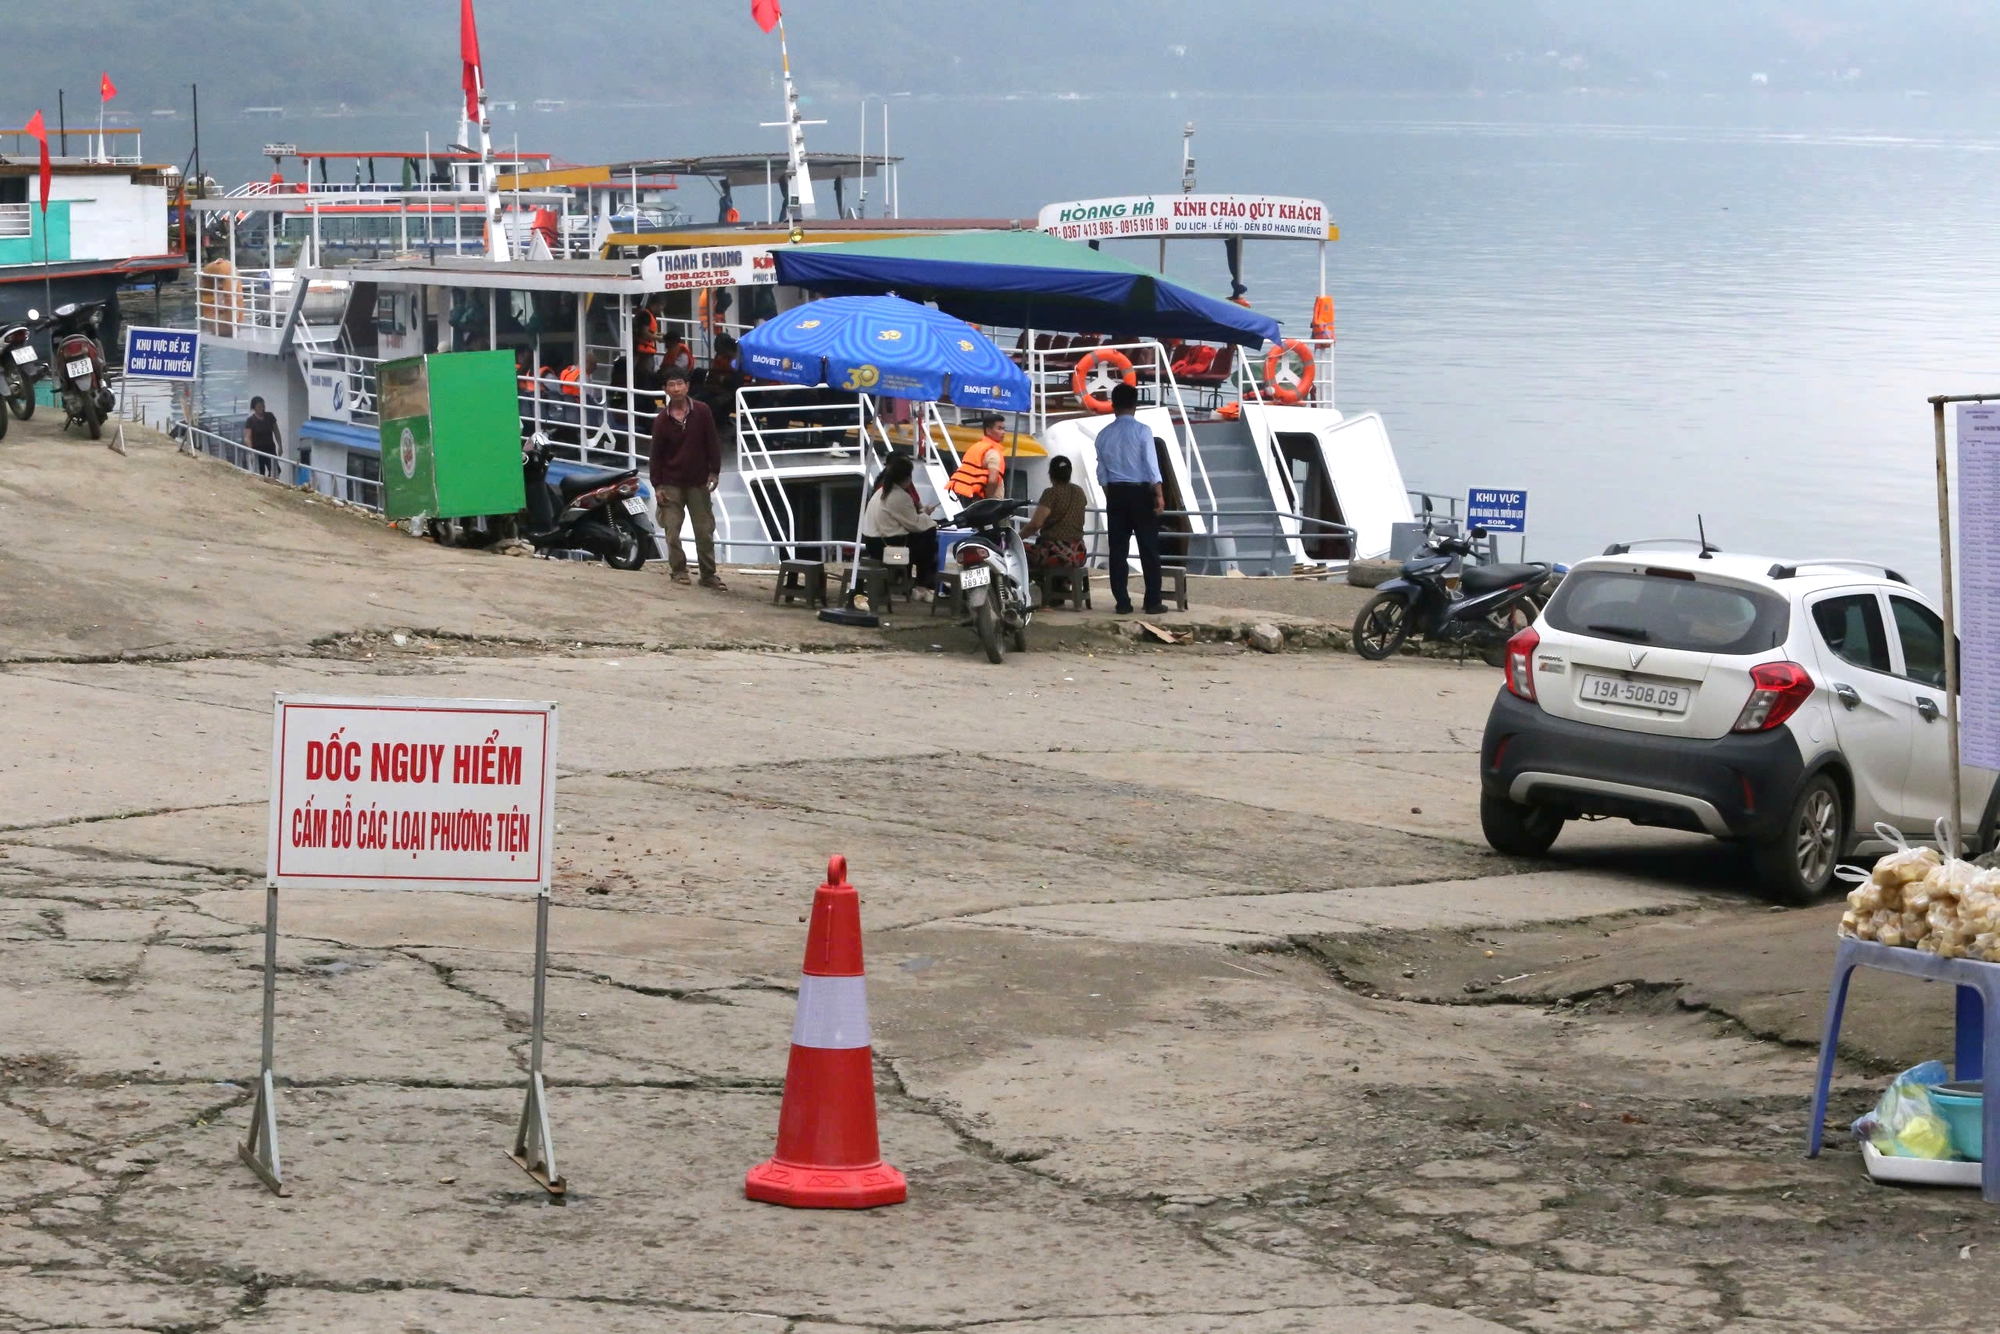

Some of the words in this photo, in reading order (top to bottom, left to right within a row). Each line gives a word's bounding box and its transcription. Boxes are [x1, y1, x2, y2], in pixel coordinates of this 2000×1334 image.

[1132, 195, 1155, 215] HÀ
[1173, 196, 1207, 217] KÍNH
[1210, 196, 1246, 217] CHÀO
[1279, 200, 1322, 221] KHÁCH
[1062, 225, 1081, 239] 0367
[1083, 222, 1098, 237] 413
[1099, 221, 1113, 236] 985
[1120, 219, 1138, 234] 0915
[1140, 218, 1153, 232] 916
[1155, 217, 1169, 231] 196
[1175, 222, 1187, 231] DU
[1189, 222, 1207, 232] LỊCH
[1274, 223, 1297, 233] HANG
[656, 253, 698, 272] THANH
[701, 250, 742, 268] CHUNG
[664, 278, 736, 290] 0948.541.624
[136, 338, 152, 351] KHU
[180, 341, 191, 354] XE
[752, 354, 782, 367] BAOVIET
[792, 362, 804, 371] Life
[843, 364, 880, 391] 30
[964, 385, 991, 395] BAOVIET
[1001, 389, 1012, 398] Life
[1476, 493, 1496, 503] KHU
[1500, 493, 1520, 506] VỰC
[1594, 681, 1678, 706] 19A-508.09
[306, 727, 361, 782] DỐC
[371, 743, 445, 783] NGUY
[453, 729, 522, 785] HIỂM
[292, 794, 328, 848] CẤM
[331, 794, 352, 849] ĐỖ
[357, 802, 387, 850] CÁC
[392, 811, 426, 859] LOẠI
[430, 808, 492, 852] PHƯƠNG
[497, 804, 530, 861] TIỆN
